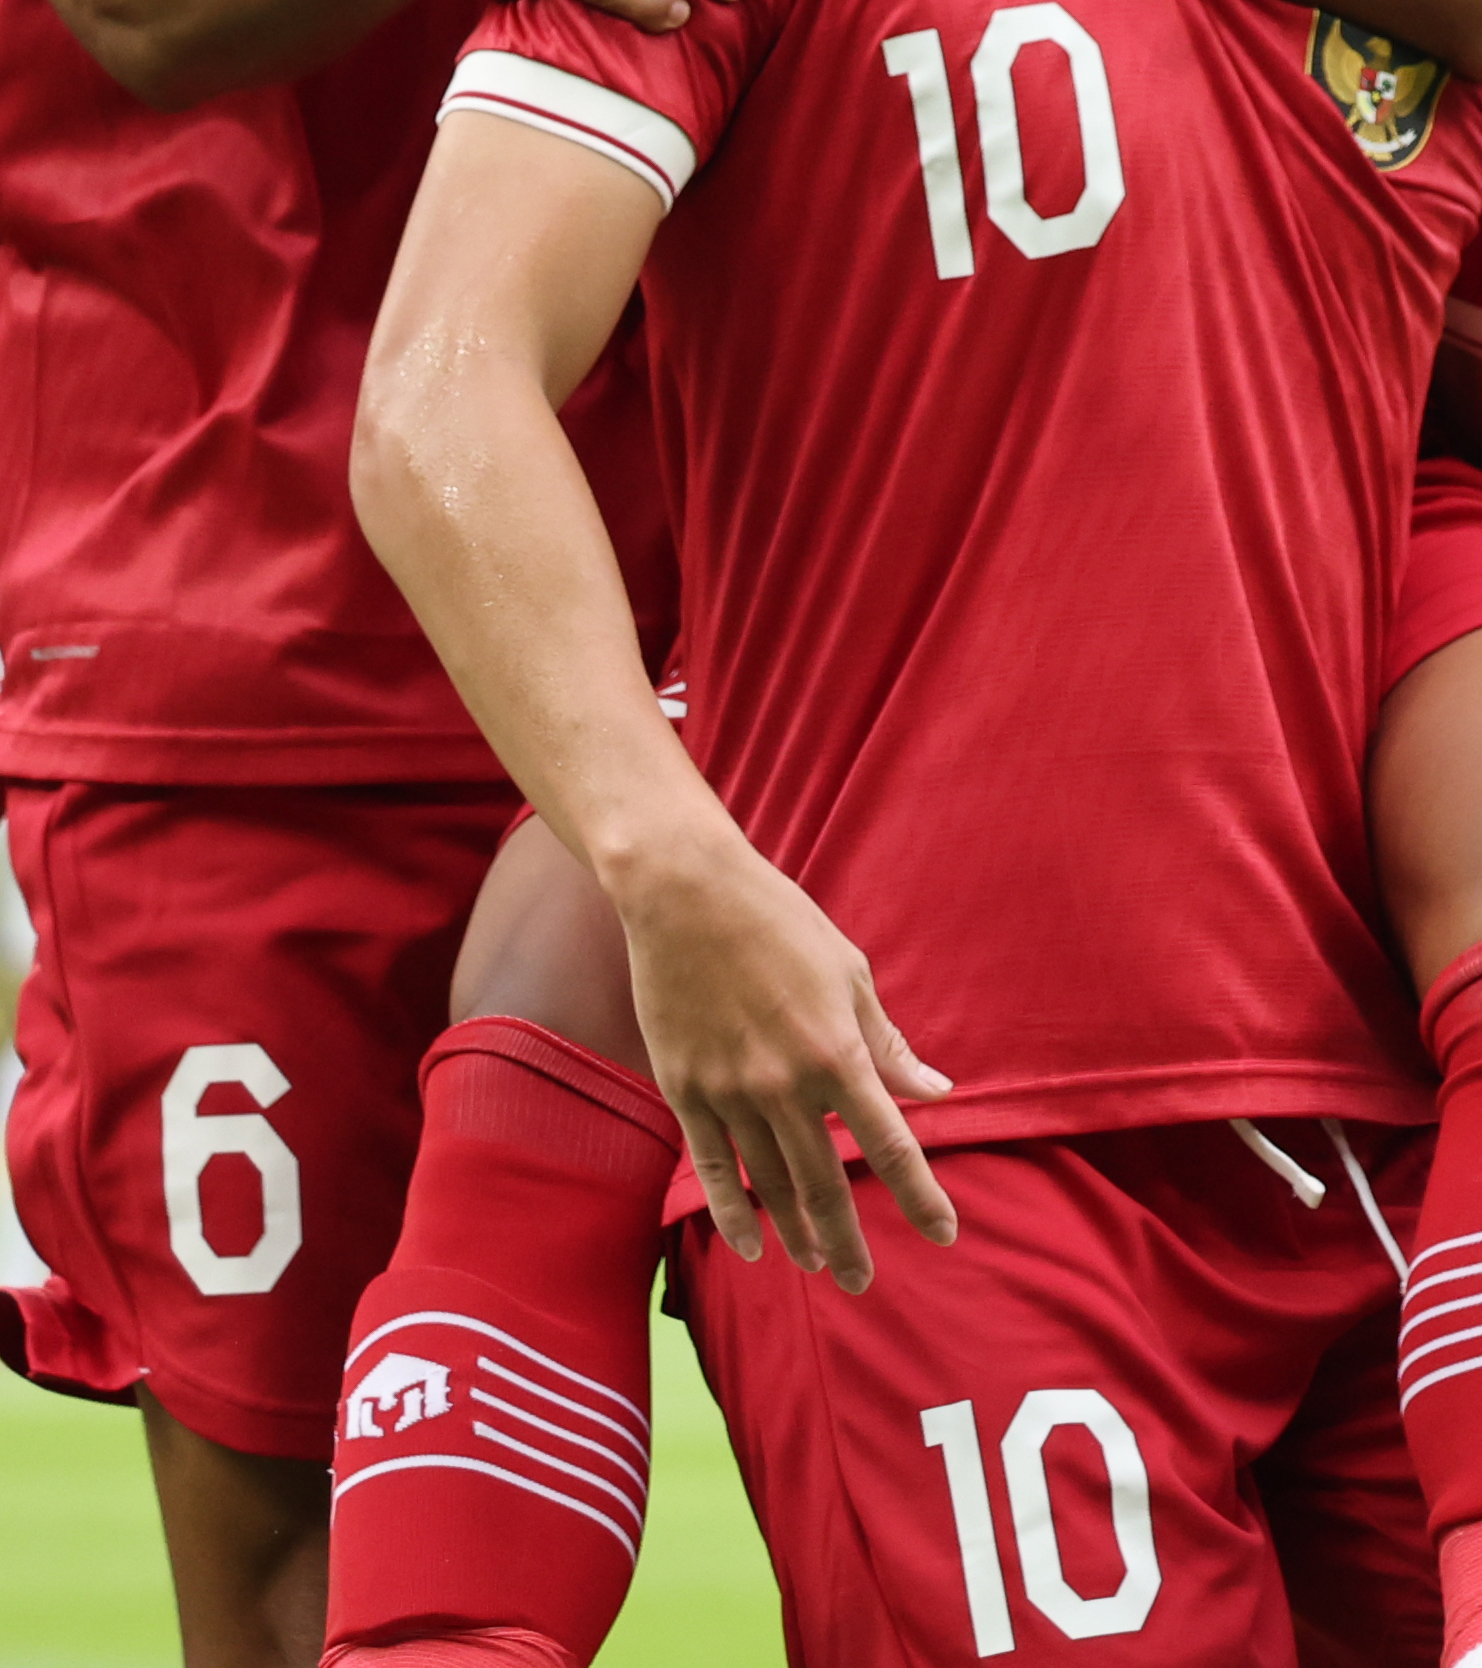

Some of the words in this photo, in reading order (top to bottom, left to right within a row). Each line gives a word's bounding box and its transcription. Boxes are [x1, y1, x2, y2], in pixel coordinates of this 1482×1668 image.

[881, 0, 1127, 281] 10
[161, 1043, 302, 1296] 6
[919, 1388, 1163, 1659] 10
